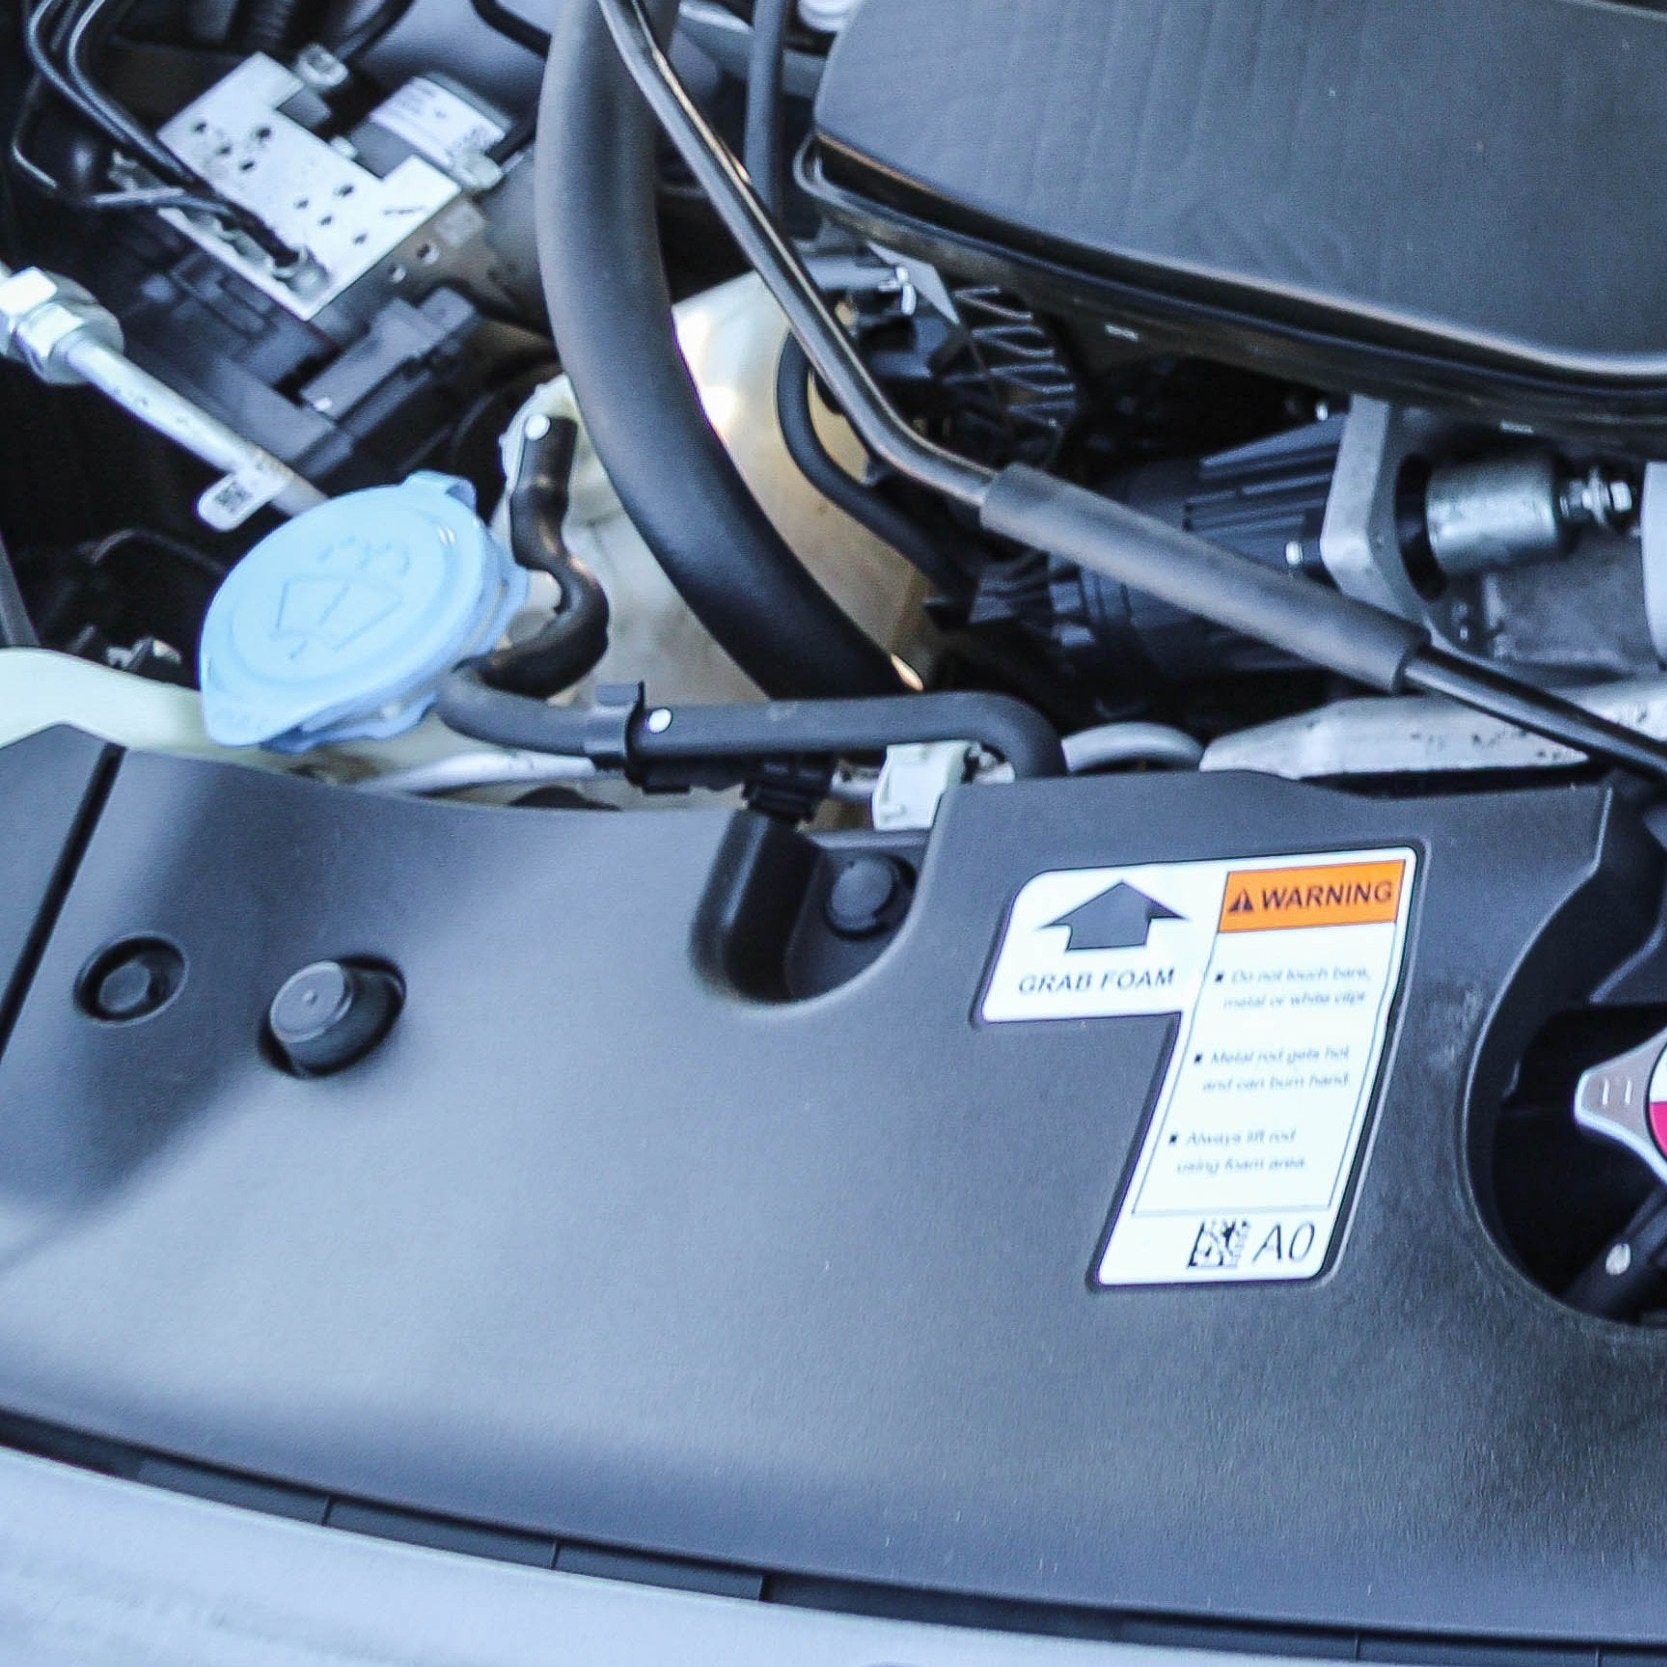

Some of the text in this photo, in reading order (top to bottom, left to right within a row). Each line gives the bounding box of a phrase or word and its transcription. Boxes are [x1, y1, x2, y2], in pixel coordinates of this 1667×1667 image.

[1260, 880, 1393, 911] WARNING
[1018, 966, 1175, 995] GRAB FOAM
[1231, 969, 1253, 984] Do
[1257, 968, 1283, 983] not
[1286, 967, 1329, 983] touch
[1223, 993, 1267, 1009] metal
[1269, 997, 1285, 1008] or
[1290, 991, 1331, 1006] white
[1211, 1050, 1255, 1065] Metal
[1258, 1049, 1284, 1064] rod
[1286, 1048, 1321, 1065] gets
[1202, 1077, 1234, 1092] and
[1236, 1079, 1266, 1092] can
[1269, 1074, 1305, 1090] burn
[1185, 1126, 1297, 1148] Always lift rod
[1176, 1159, 1220, 1177] using
[1224, 1157, 1264, 1171] foam
